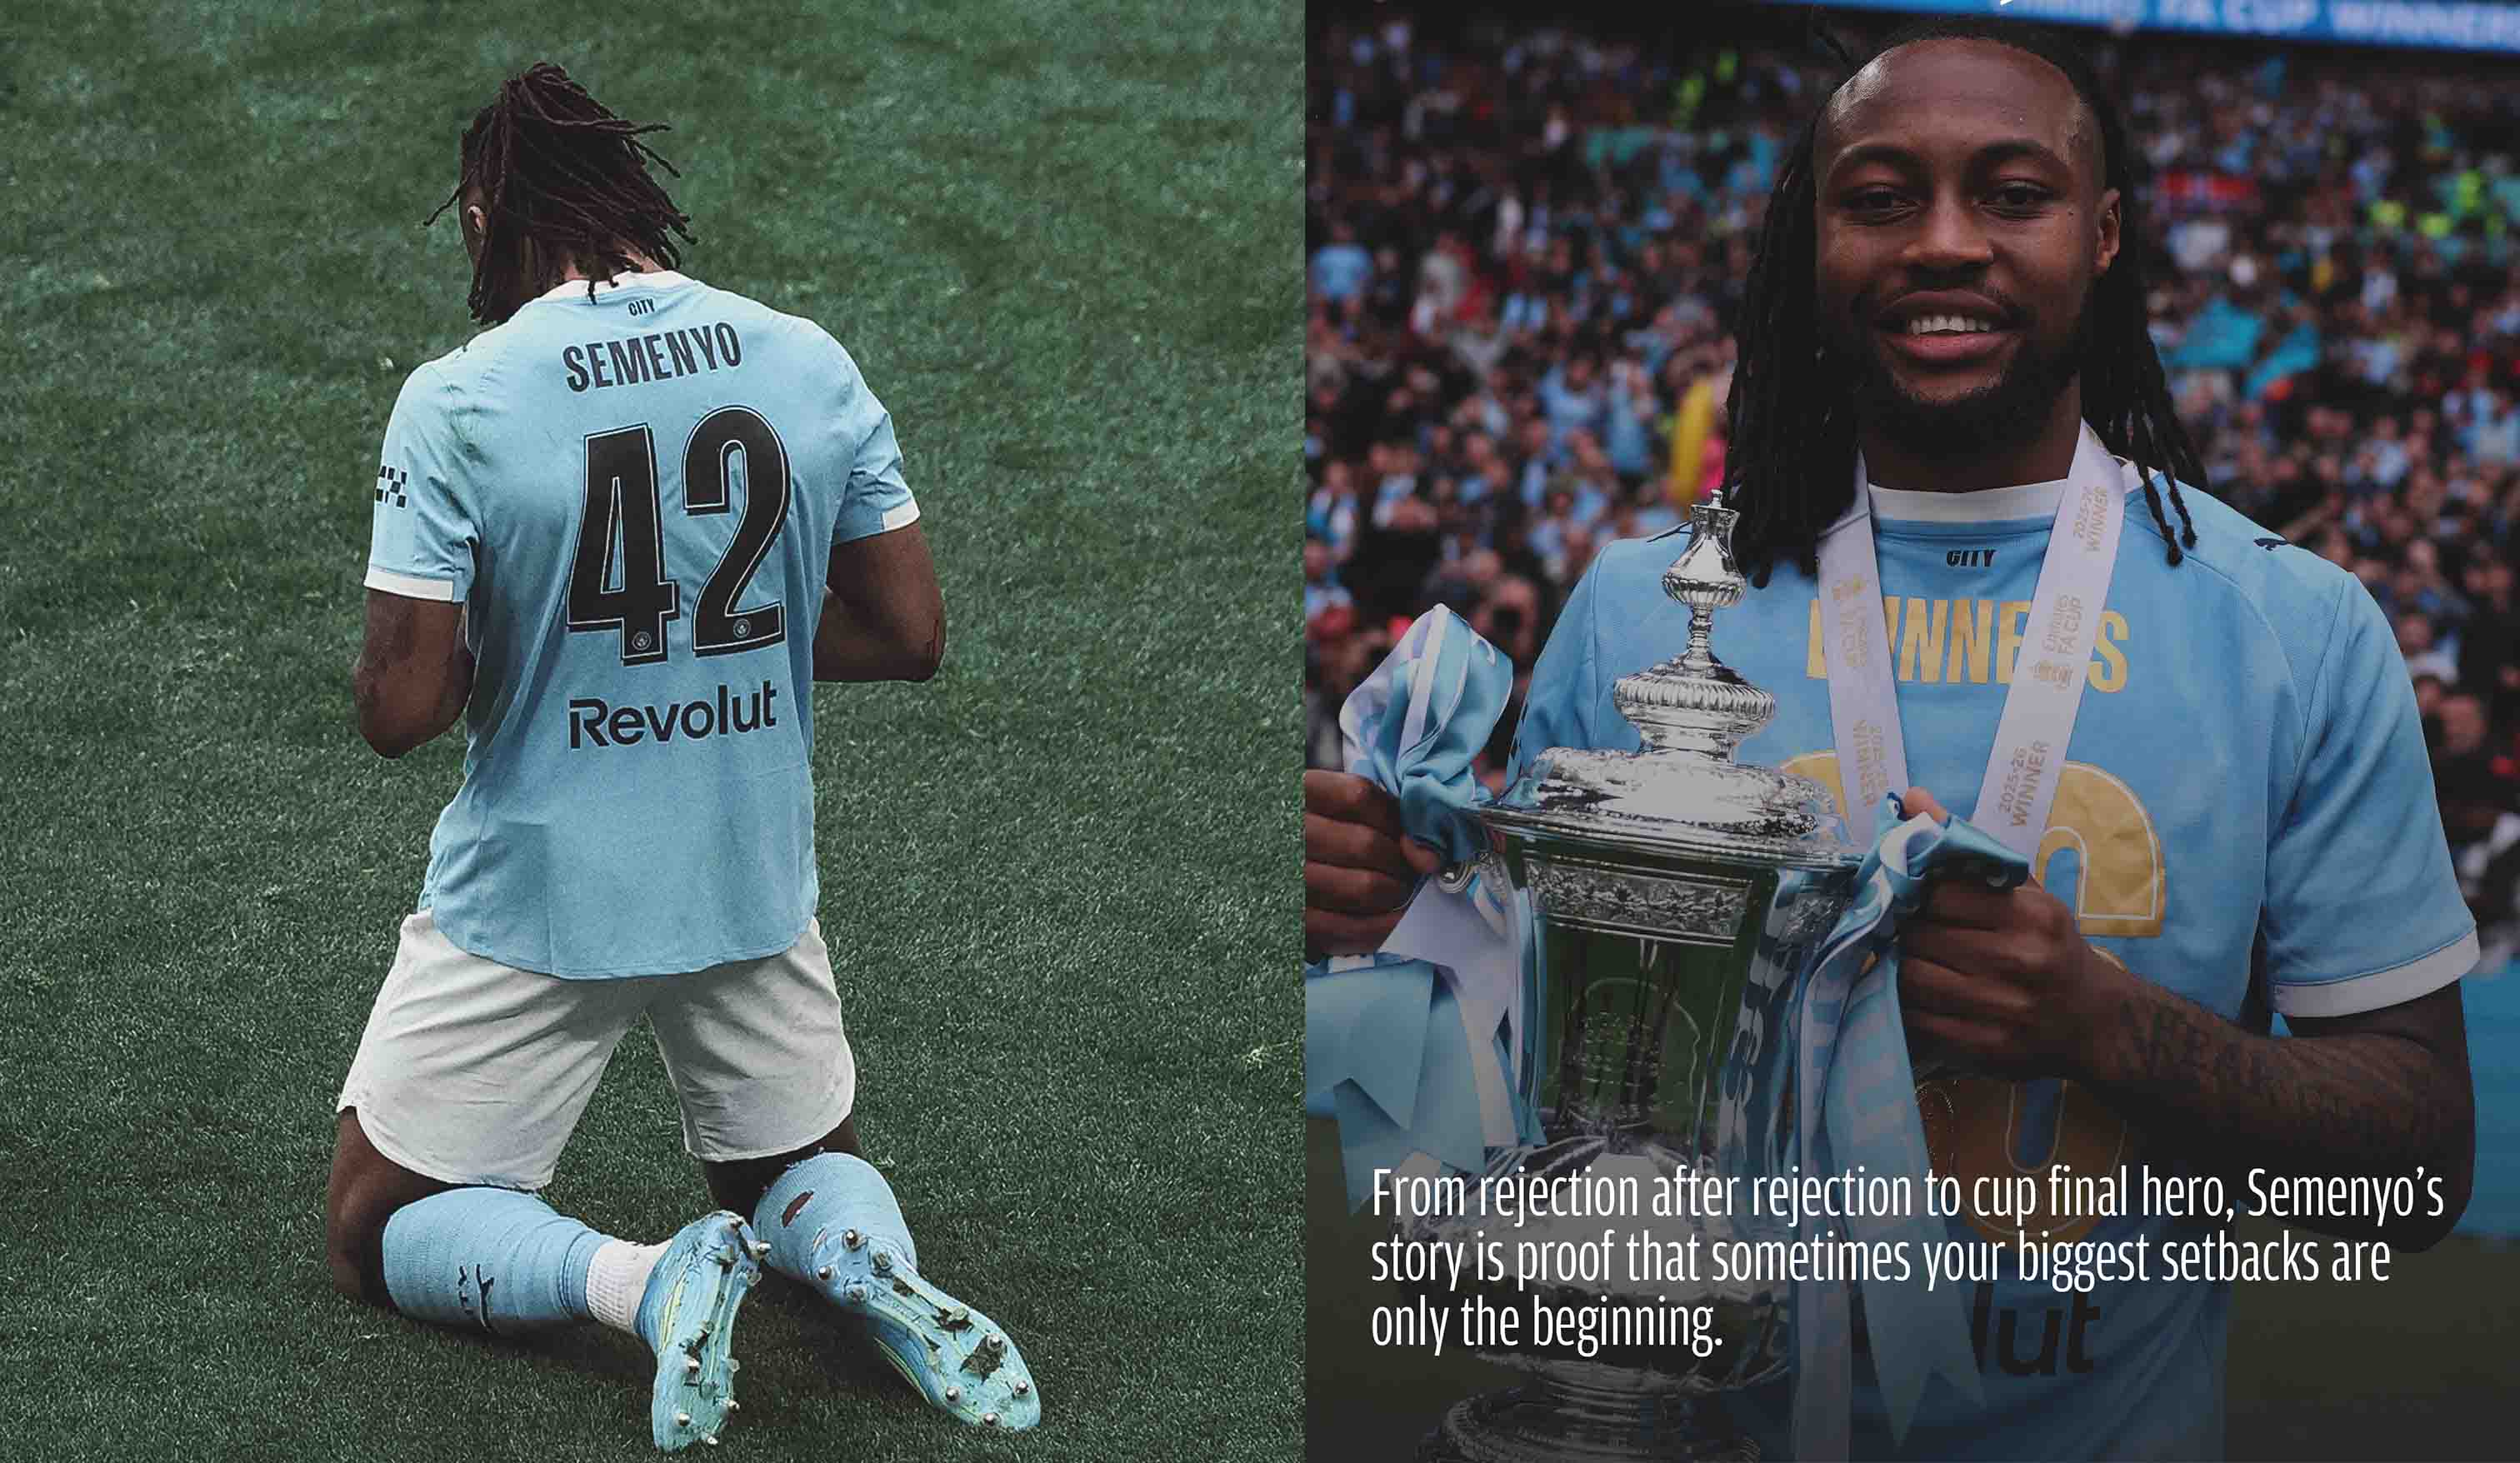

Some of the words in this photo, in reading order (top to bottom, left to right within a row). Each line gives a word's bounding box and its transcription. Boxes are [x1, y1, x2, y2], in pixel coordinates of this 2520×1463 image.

[628, 297, 656, 317] CITY
[562, 322, 742, 392] SEMENYO
[567, 405, 792, 666] 42
[1946, 549, 1997, 567] CITY
[1806, 595, 2130, 693] NNES
[568, 680, 777, 750] Revolut
[2009, 739, 2050, 827] WINNER
